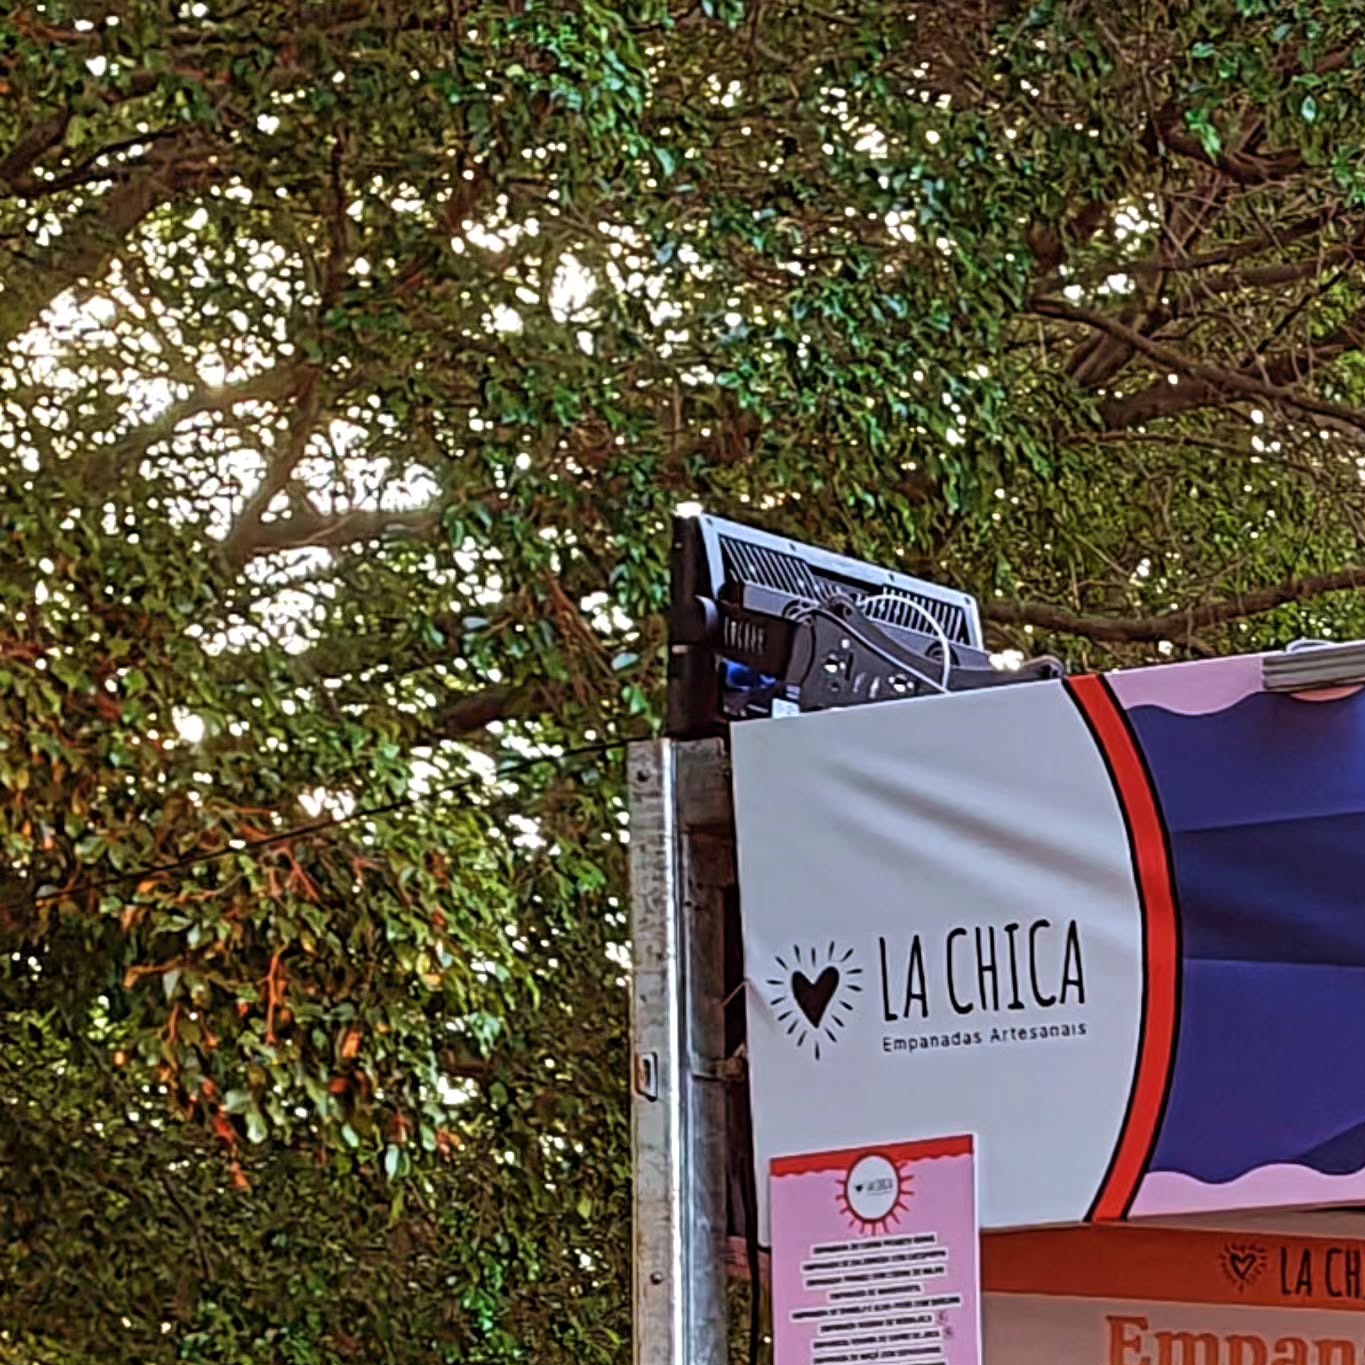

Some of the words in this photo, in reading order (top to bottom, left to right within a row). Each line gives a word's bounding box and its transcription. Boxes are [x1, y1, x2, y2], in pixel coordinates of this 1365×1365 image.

[879, 934, 930, 1022] LA
[945, 918, 1087, 1016] CHICA
[881, 1028, 983, 1053] Empanadas
[989, 1021, 1088, 1043] Artesanais
[1280, 1246, 1313, 1298] LA
